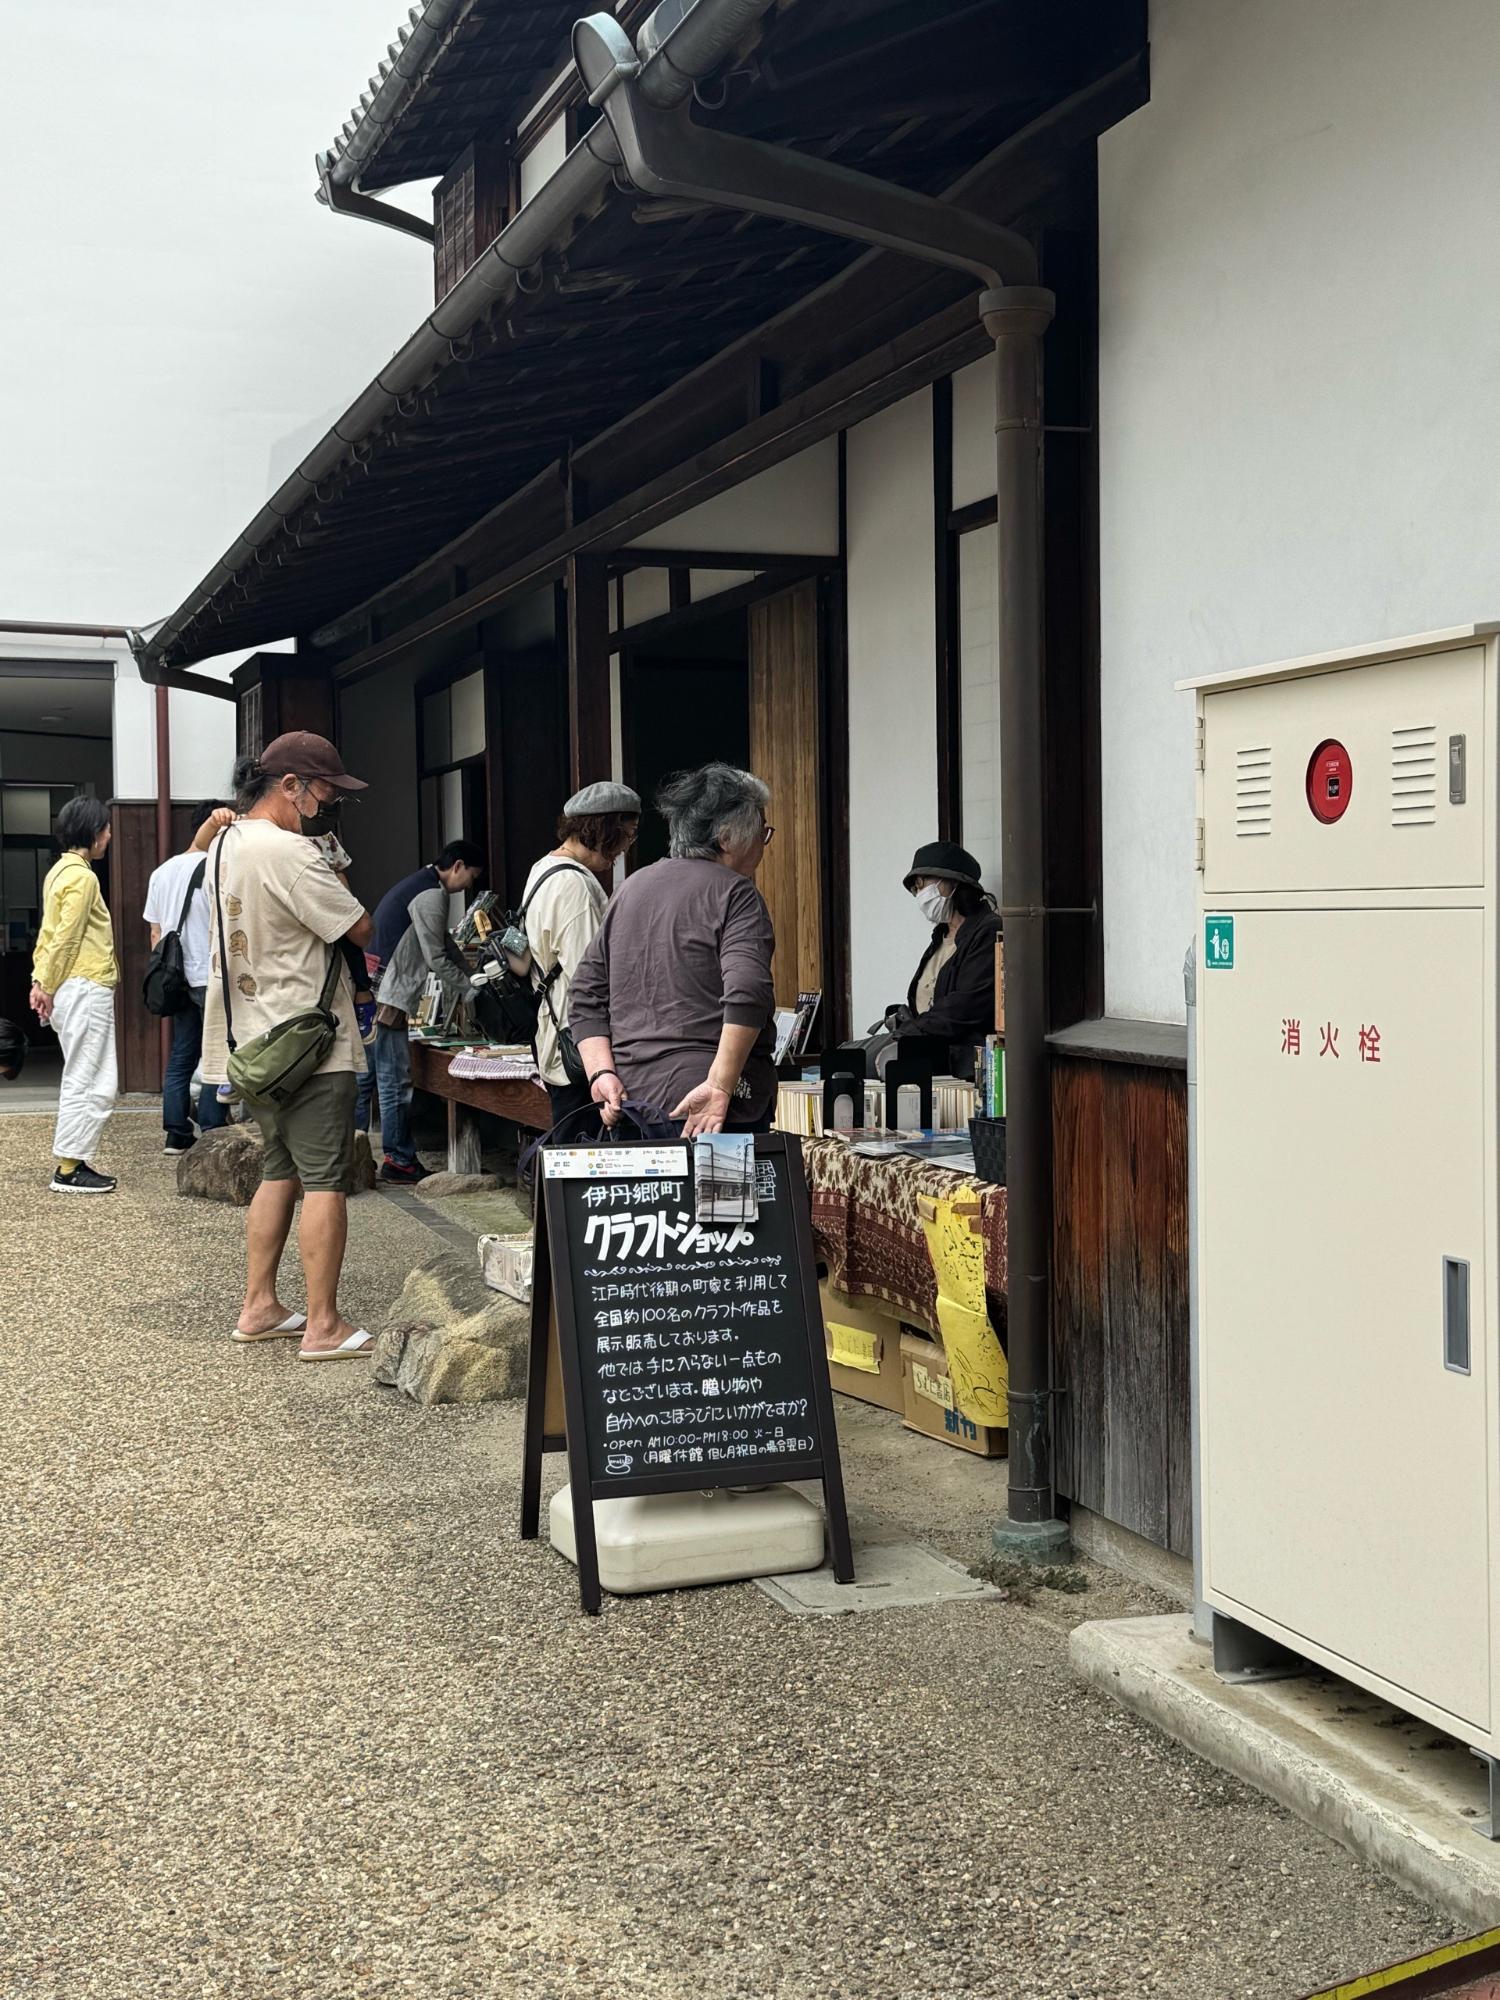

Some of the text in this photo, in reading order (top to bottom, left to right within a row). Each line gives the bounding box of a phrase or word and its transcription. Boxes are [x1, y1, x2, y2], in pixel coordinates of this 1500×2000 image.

[1281, 1018, 1381, 1062] 消火栓
[581, 1181, 684, 1208] 伊丹郷町
[591, 1274, 788, 1302] 江戸時代後期の町家を利用して
[593, 1299, 784, 1328] 全国約100名のクラフト作品を
[597, 1350, 782, 1379] 他では手に入らない一点もの
